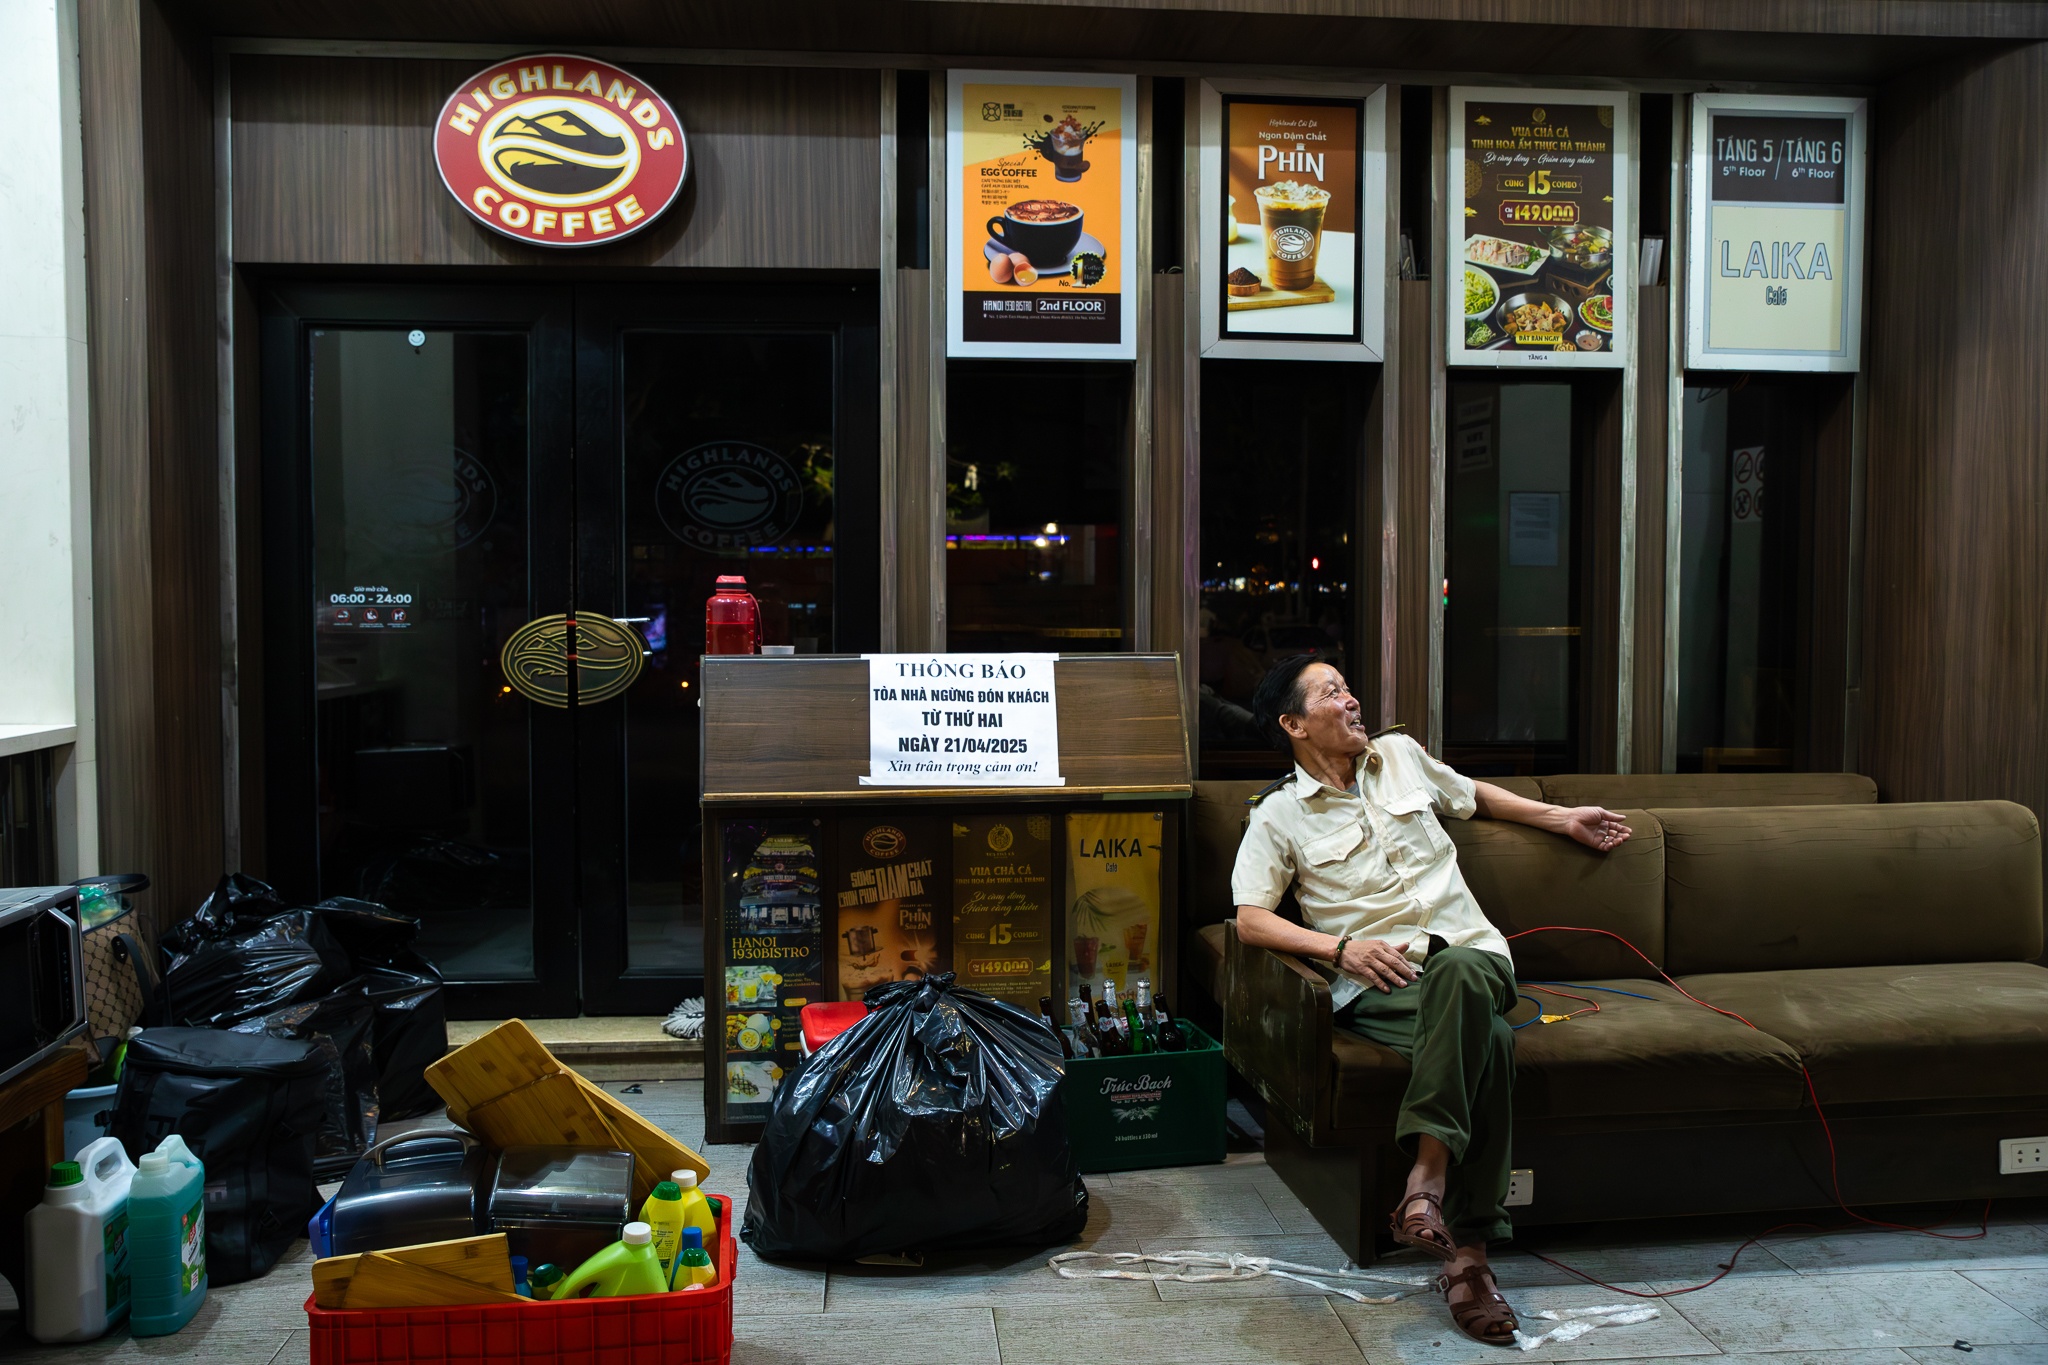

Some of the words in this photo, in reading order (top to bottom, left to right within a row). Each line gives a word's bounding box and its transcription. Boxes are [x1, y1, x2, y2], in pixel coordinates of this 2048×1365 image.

[448, 65, 674, 151] HIGHLANDS
[1258, 131, 1281, 141] Ngon
[1283, 132, 1304, 141] Đậm
[1511, 126, 1531, 137] VUA
[1556, 125, 1569, 138] CÁ
[1471, 139, 1494, 149] TINH
[1495, 140, 1515, 149] HOA
[1763, 140, 1773, 163] 5
[1832, 141, 1841, 165] 6
[997, 157, 1027, 170] Special
[1258, 143, 1324, 182] PHIN
[1723, 165, 1736, 177] 5th
[1739, 167, 1766, 177] Floor
[981, 168, 1000, 177] EGG
[1002, 169, 1038, 178] COFFEE
[1792, 167, 1805, 178] 6th
[1809, 169, 1835, 179] Floor
[1527, 170, 1552, 195] 15
[1551, 181, 1577, 189] COMBO
[473, 186, 646, 237] COFFEE
[1272, 228, 1312, 242] HIGHLANDS
[1276, 250, 1306, 260] COFFEE
[1721, 240, 1833, 280] LAIKA
[1071, 258, 1087, 288] 1
[1765, 285, 1788, 306] Café
[983, 301, 1004, 311] HANOI
[1039, 301, 1060, 311] 2nd
[1062, 301, 1102, 312] FLOOR
[665, 447, 794, 492] HIGHLANDS
[682, 521, 780, 547] COFFEE
[330, 594, 366, 604] 06:00
[376, 594, 412, 604] 24:00
[895, 658, 974, 678] THÔNG
[981, 661, 1026, 679] BÁO
[873, 686, 897, 701] TÒA
[901, 686, 927, 701] NHÀ
[931, 687, 974, 703] NGỪNG
[978, 688, 1004, 703] ĐÓN
[1007, 688, 1050, 703] KHÁCH
[921, 709, 942, 726] TỪ
[944, 709, 975, 727] THỨ
[978, 713, 1003, 727] HAI
[898, 734, 940, 752] NGÀY
[944, 738, 1028, 753] 21/04/2025
[887, 760, 913, 772] Xin
[915, 760, 942, 772] trân
[946, 761, 981, 775] trọng
[1015, 761, 1038, 772] ơn!
[865, 827, 904, 841] HIGHLANDS
[1079, 838, 1143, 858] LAIKA
[969, 866, 991, 876] VUA
[1017, 864, 1032, 875] CÁ
[859, 887, 879, 905] PHIN
[900, 908, 932, 926] PHIN
[732, 936, 777, 948] HANOI
[989, 923, 1012, 945] 15
[1012, 931, 1038, 939] COMBO
[733, 946, 810, 960] 1930BISTRO
[1099, 1077, 1132, 1095] Trúc
[1133, 1074, 1172, 1092] Bạch
